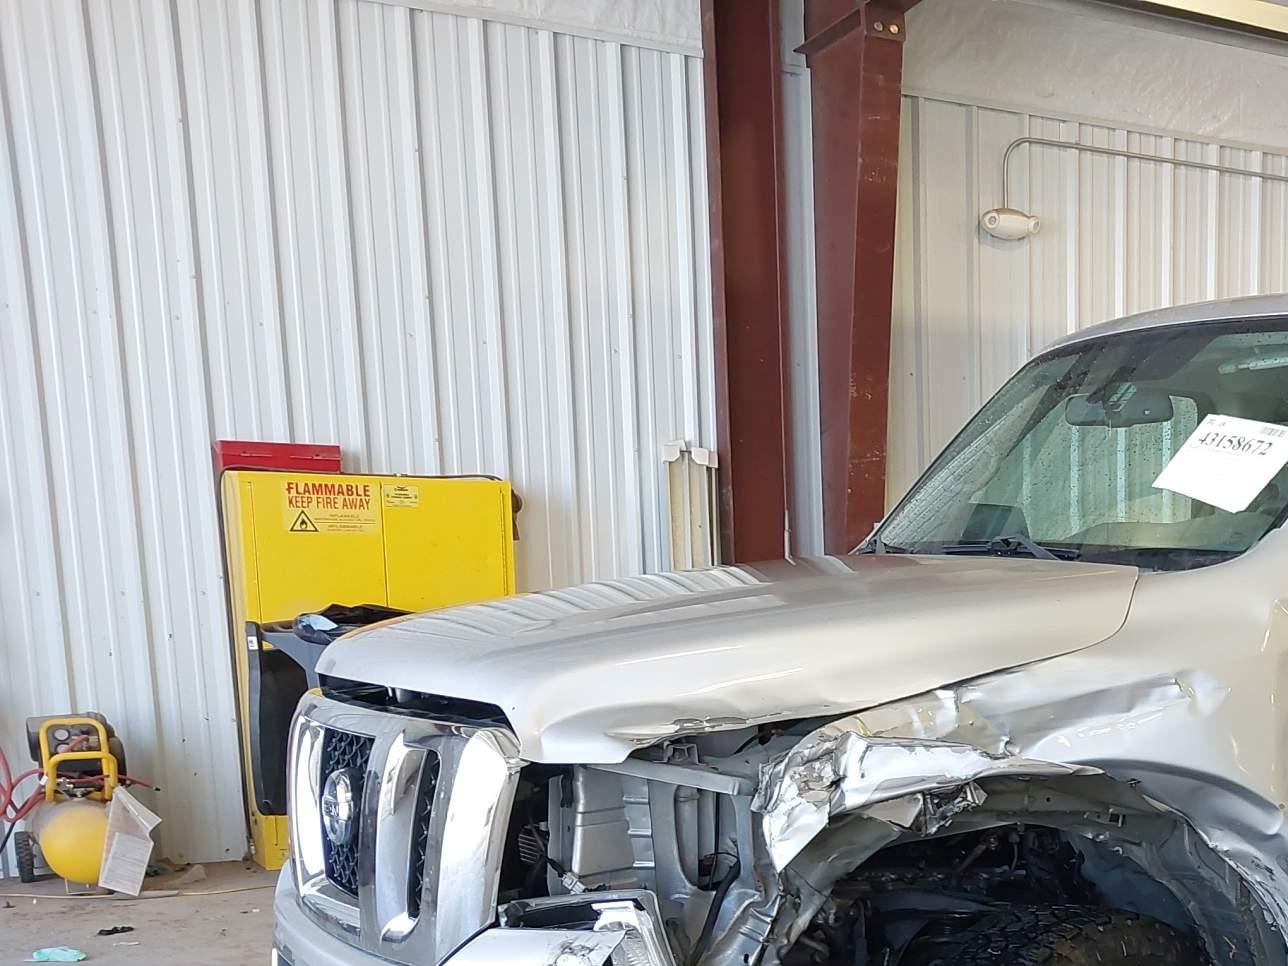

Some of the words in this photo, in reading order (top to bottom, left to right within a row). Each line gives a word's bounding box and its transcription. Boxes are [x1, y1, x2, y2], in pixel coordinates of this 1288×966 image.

[1198, 431, 1273, 456] 43158672
[286, 482, 371, 497] FLAMMABLE
[288, 496, 313, 509] KEEP
[316, 497, 339, 510] FIRE
[342, 497, 371, 510] AWAY
